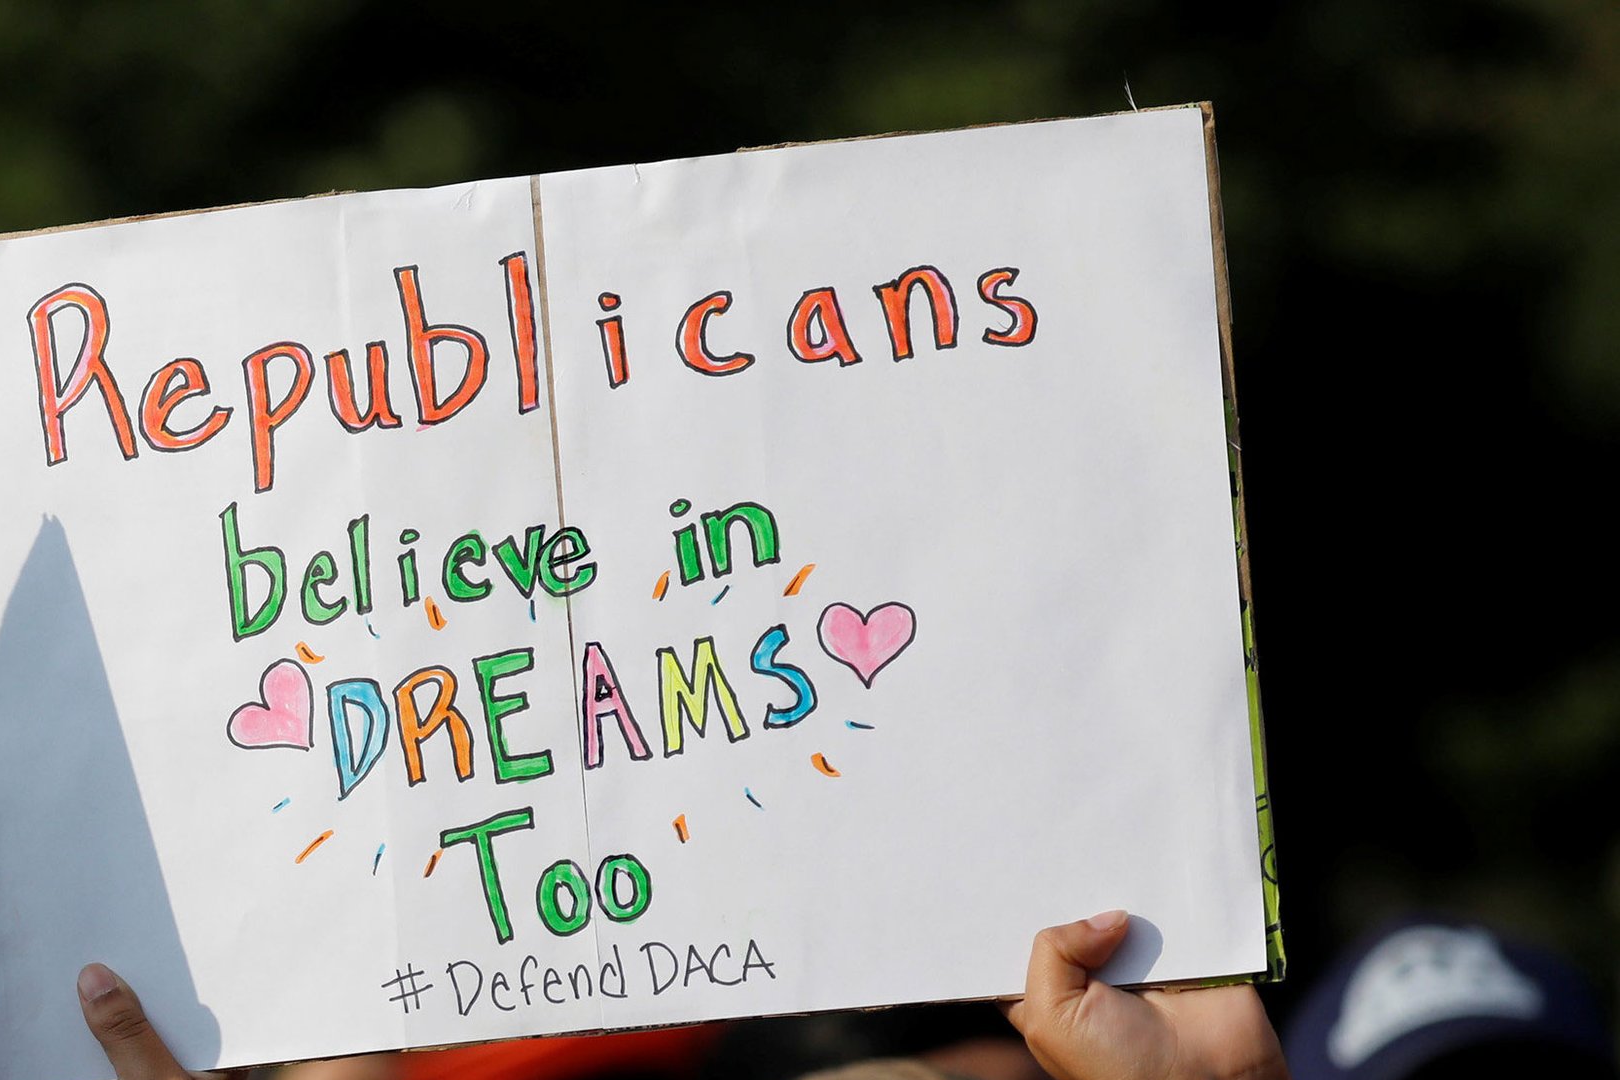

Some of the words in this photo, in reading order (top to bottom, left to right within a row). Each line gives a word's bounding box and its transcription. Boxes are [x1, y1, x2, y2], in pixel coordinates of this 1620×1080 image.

[27, 251, 1039, 493] Republicans
[219, 502, 597, 641] believe
[669, 498, 781, 586] in
[326, 625, 819, 800] DREAMS
